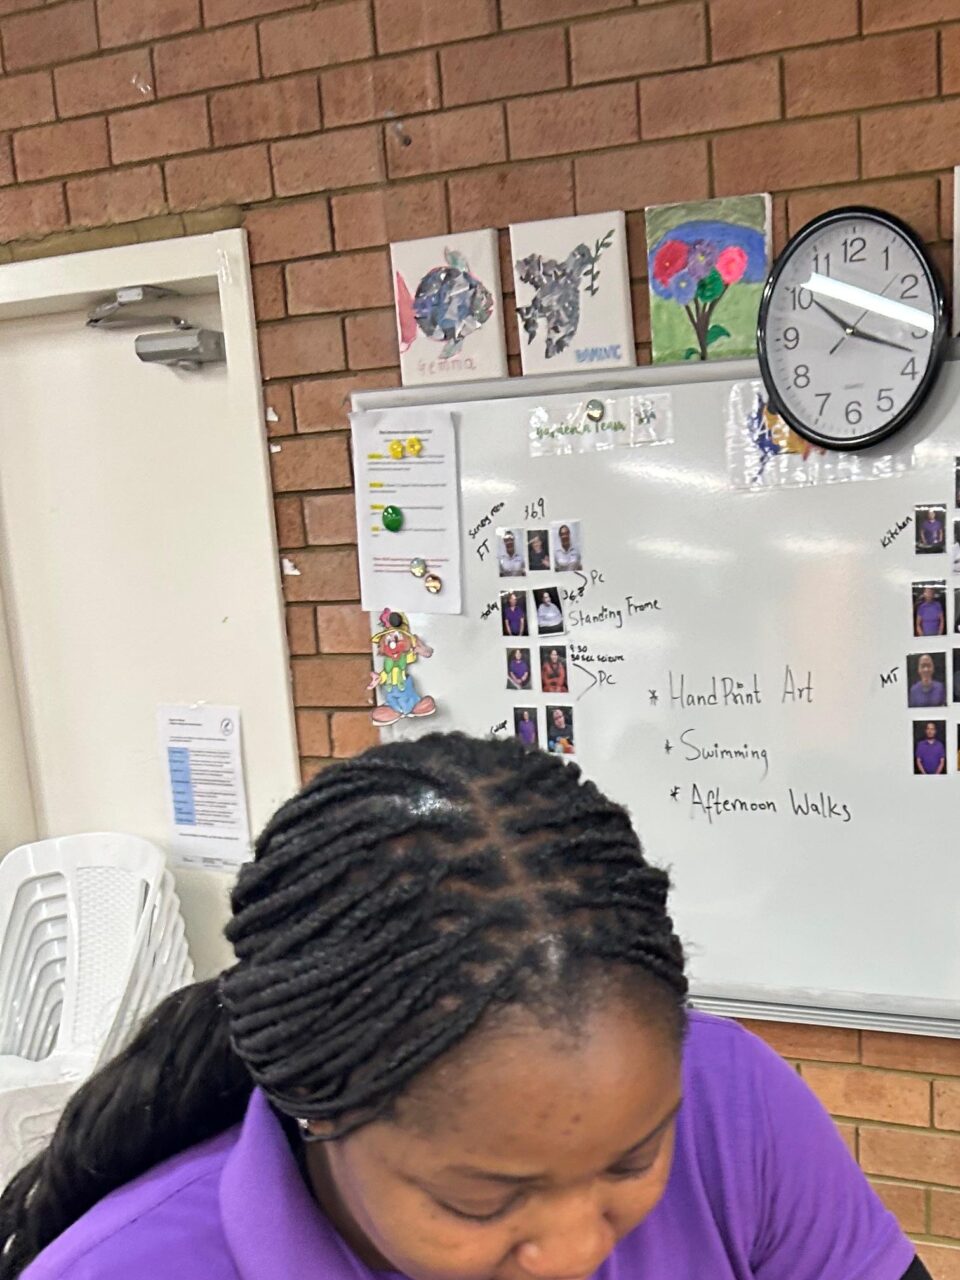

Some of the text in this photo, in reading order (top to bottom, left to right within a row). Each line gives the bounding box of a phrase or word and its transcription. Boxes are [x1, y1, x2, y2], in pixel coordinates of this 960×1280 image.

[842, 237, 867, 264] 12
[882, 246, 890, 271] 1
[813, 253, 831, 275] 11
[789, 287, 814, 310] 10
[900, 274, 919, 300] 2
[783, 327, 799, 350] 9
[793, 364, 811, 389] 8
[900, 357, 919, 381] 4
[814, 392, 832, 417] 7
[844, 400, 863, 425] 6
[876, 388, 894, 412] 5
[781, 664, 814, 704] Art
[679, 728, 769, 780] Swimming
[690, 782, 852, 825] Afternoon Walks
